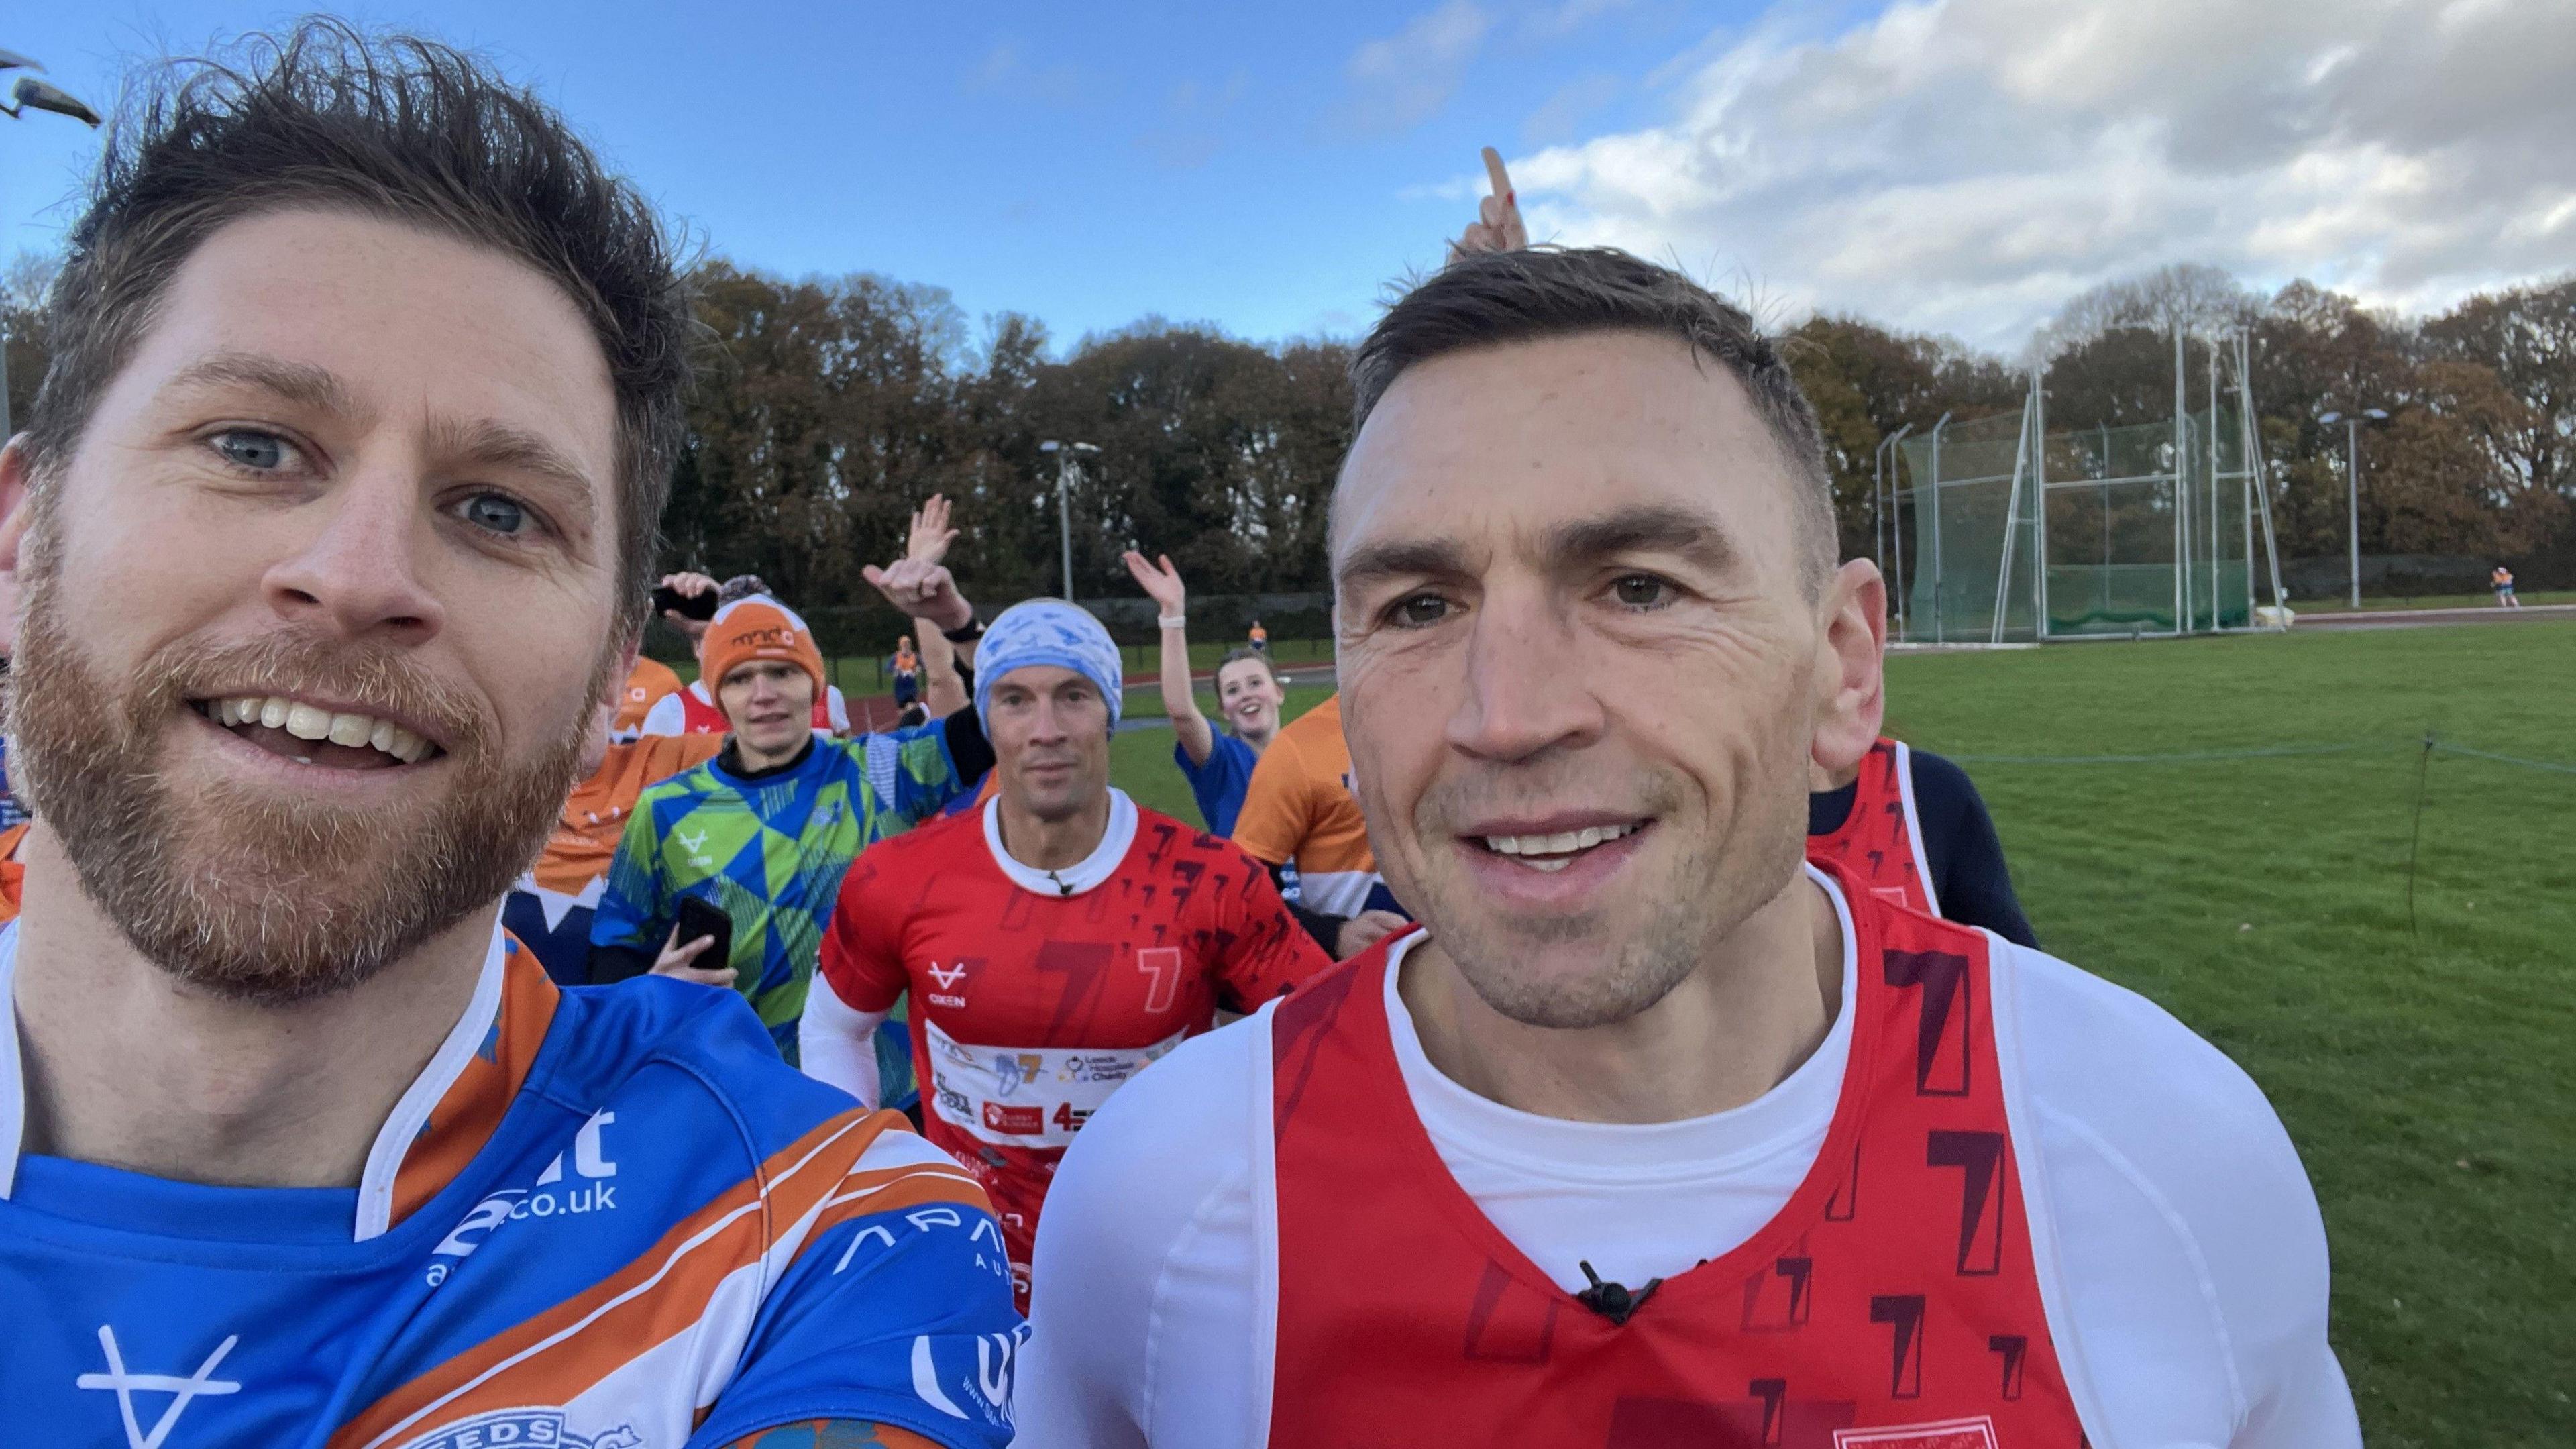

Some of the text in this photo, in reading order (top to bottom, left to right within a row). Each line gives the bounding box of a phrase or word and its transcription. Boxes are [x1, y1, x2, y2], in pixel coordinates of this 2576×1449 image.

[1137, 946, 1182, 1014] 7
[1882, 949, 1971, 1097] 7
[1927, 1130, 2004, 1275] 7
[1870, 1294, 1925, 1400] 7
[1989, 1335, 2027, 1401] 7
[431, 1420, 555, 1449] EDS
[1749, 1378, 1786, 1447] 7
